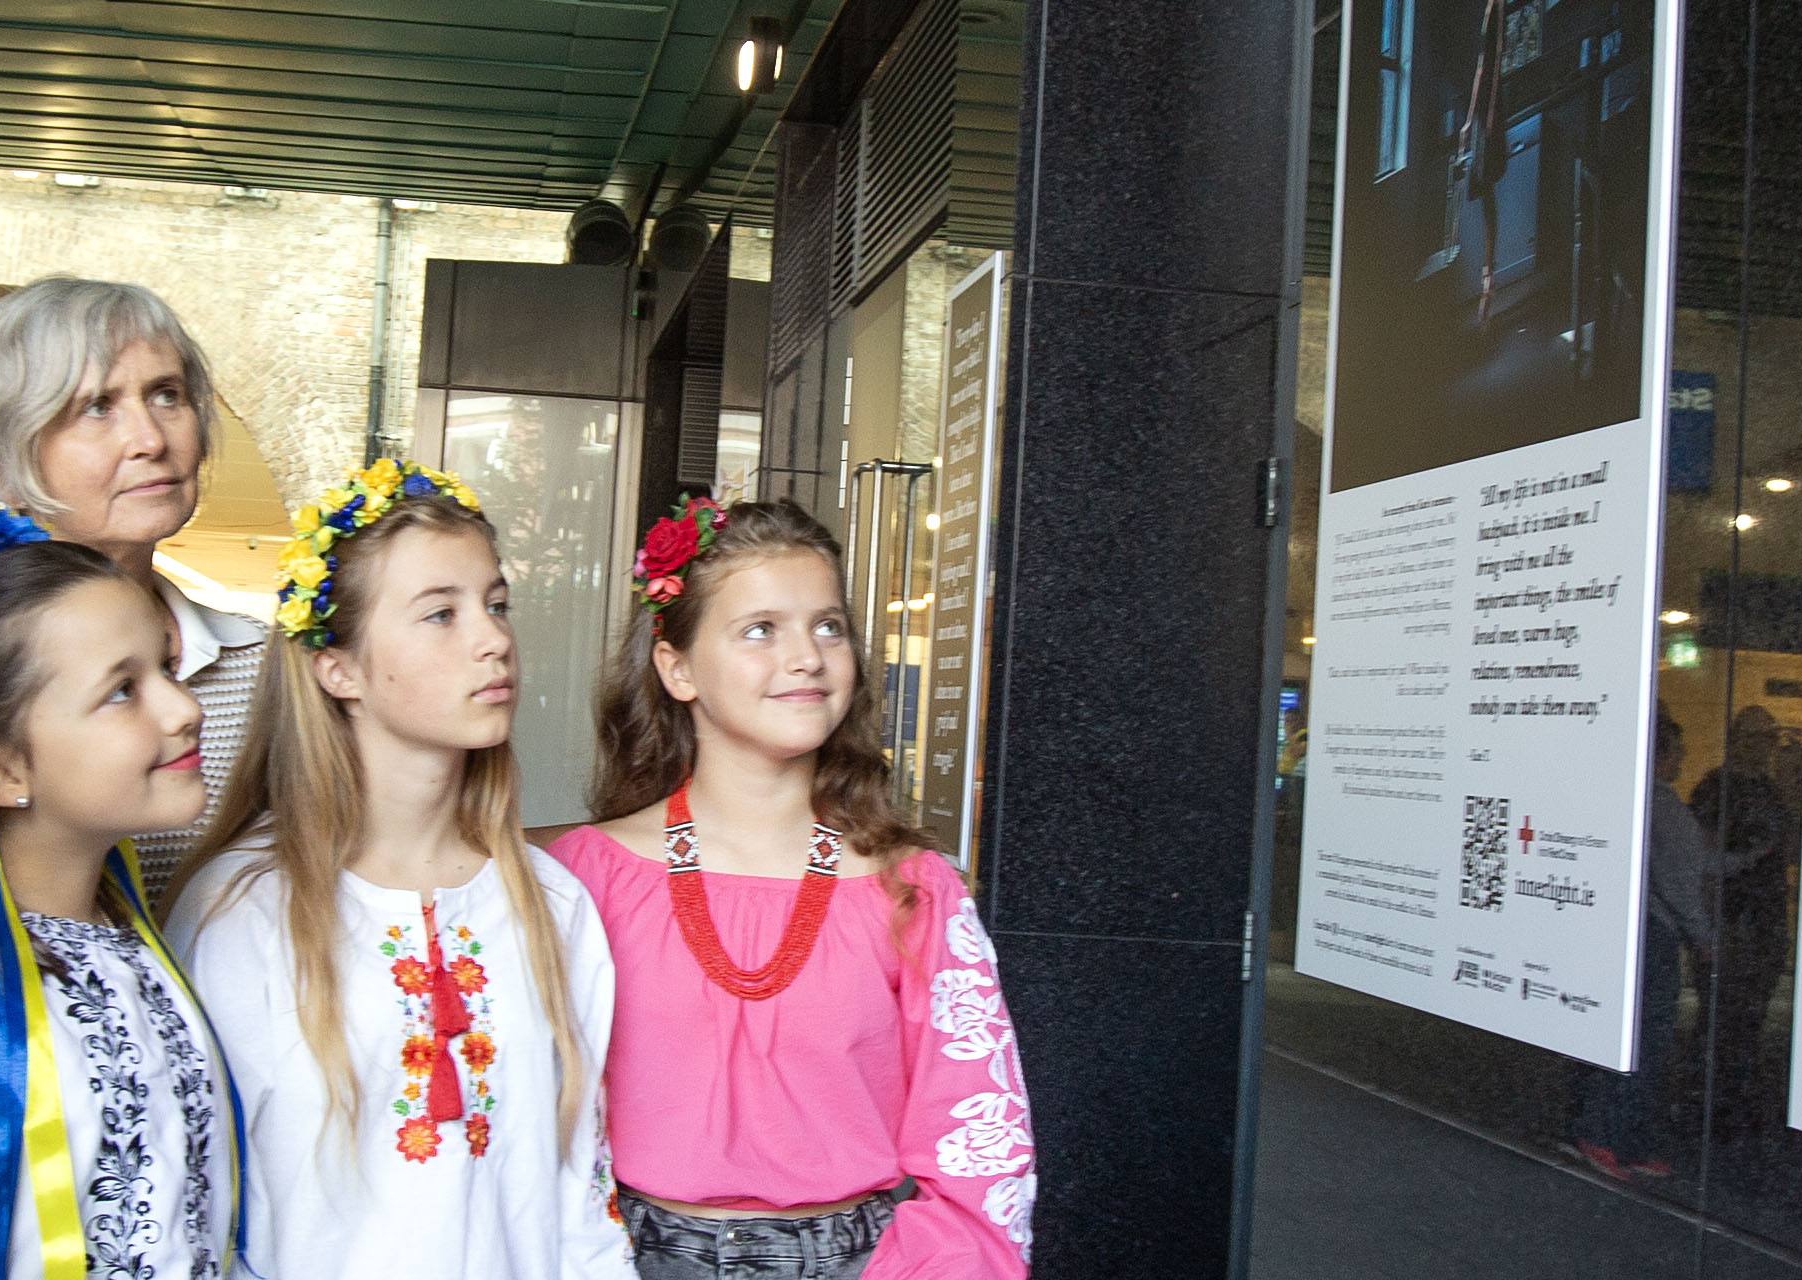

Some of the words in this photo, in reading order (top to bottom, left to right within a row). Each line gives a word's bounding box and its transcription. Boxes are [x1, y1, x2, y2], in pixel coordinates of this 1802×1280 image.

[1580, 460, 1611, 488] small
[1591, 500, 1602, 524] I
[1526, 556, 1541, 571] me
[1542, 545, 1558, 568] all
[1558, 543, 1575, 566] the
[1555, 581, 1572, 603] the
[1607, 575, 1622, 607] of
[1523, 627, 1552, 642] warm
[1514, 870, 1597, 911] innerlight.ie
